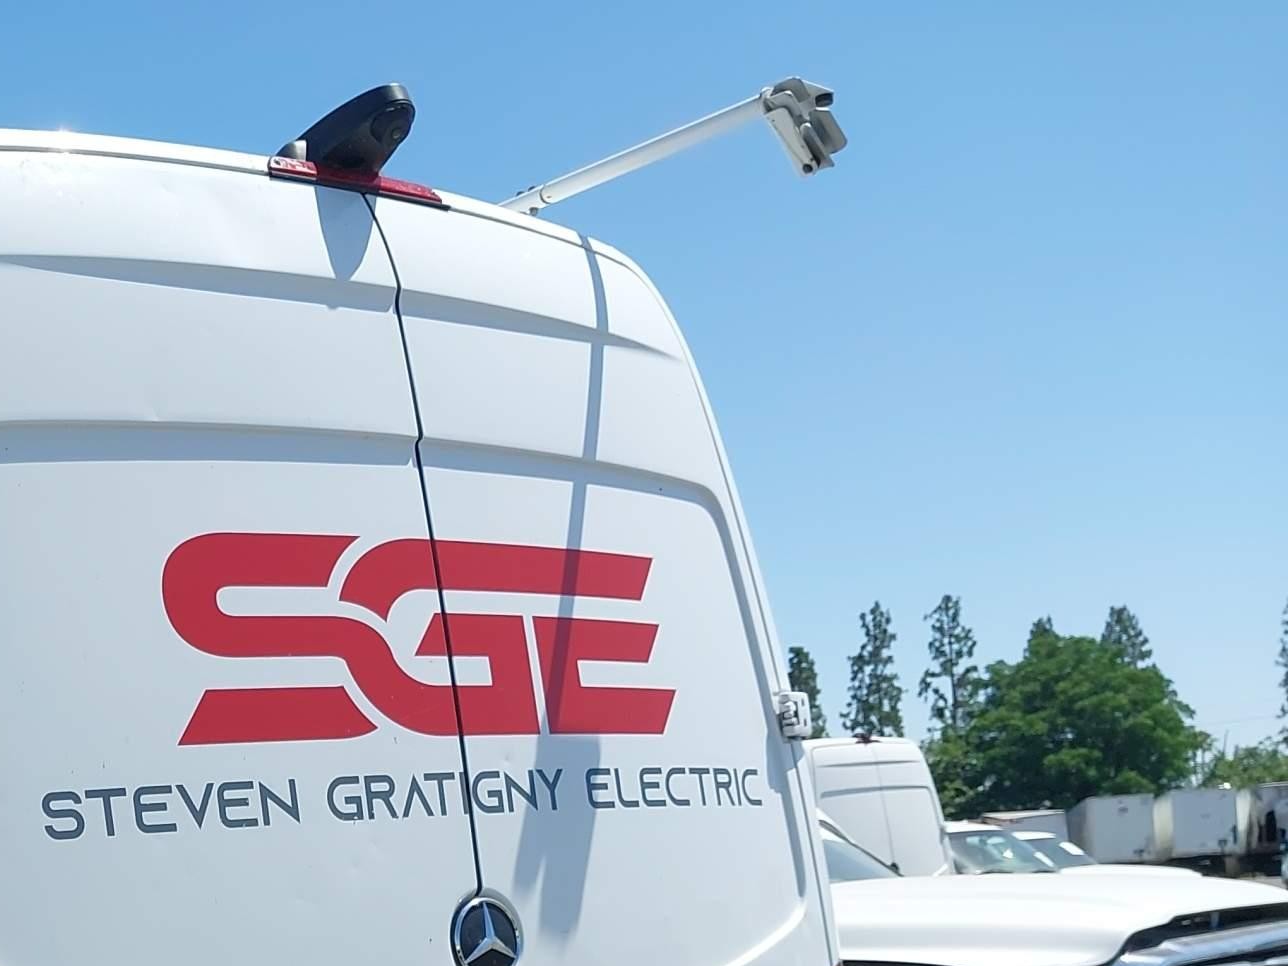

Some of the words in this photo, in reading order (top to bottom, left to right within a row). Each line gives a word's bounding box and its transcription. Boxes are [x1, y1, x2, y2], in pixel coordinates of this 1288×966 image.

[161, 532, 676, 746] SGE
[43, 778, 300, 840] STEVEN
[327, 767, 562, 821] GRATIGNY
[586, 767, 762, 809] ELECTRIC
